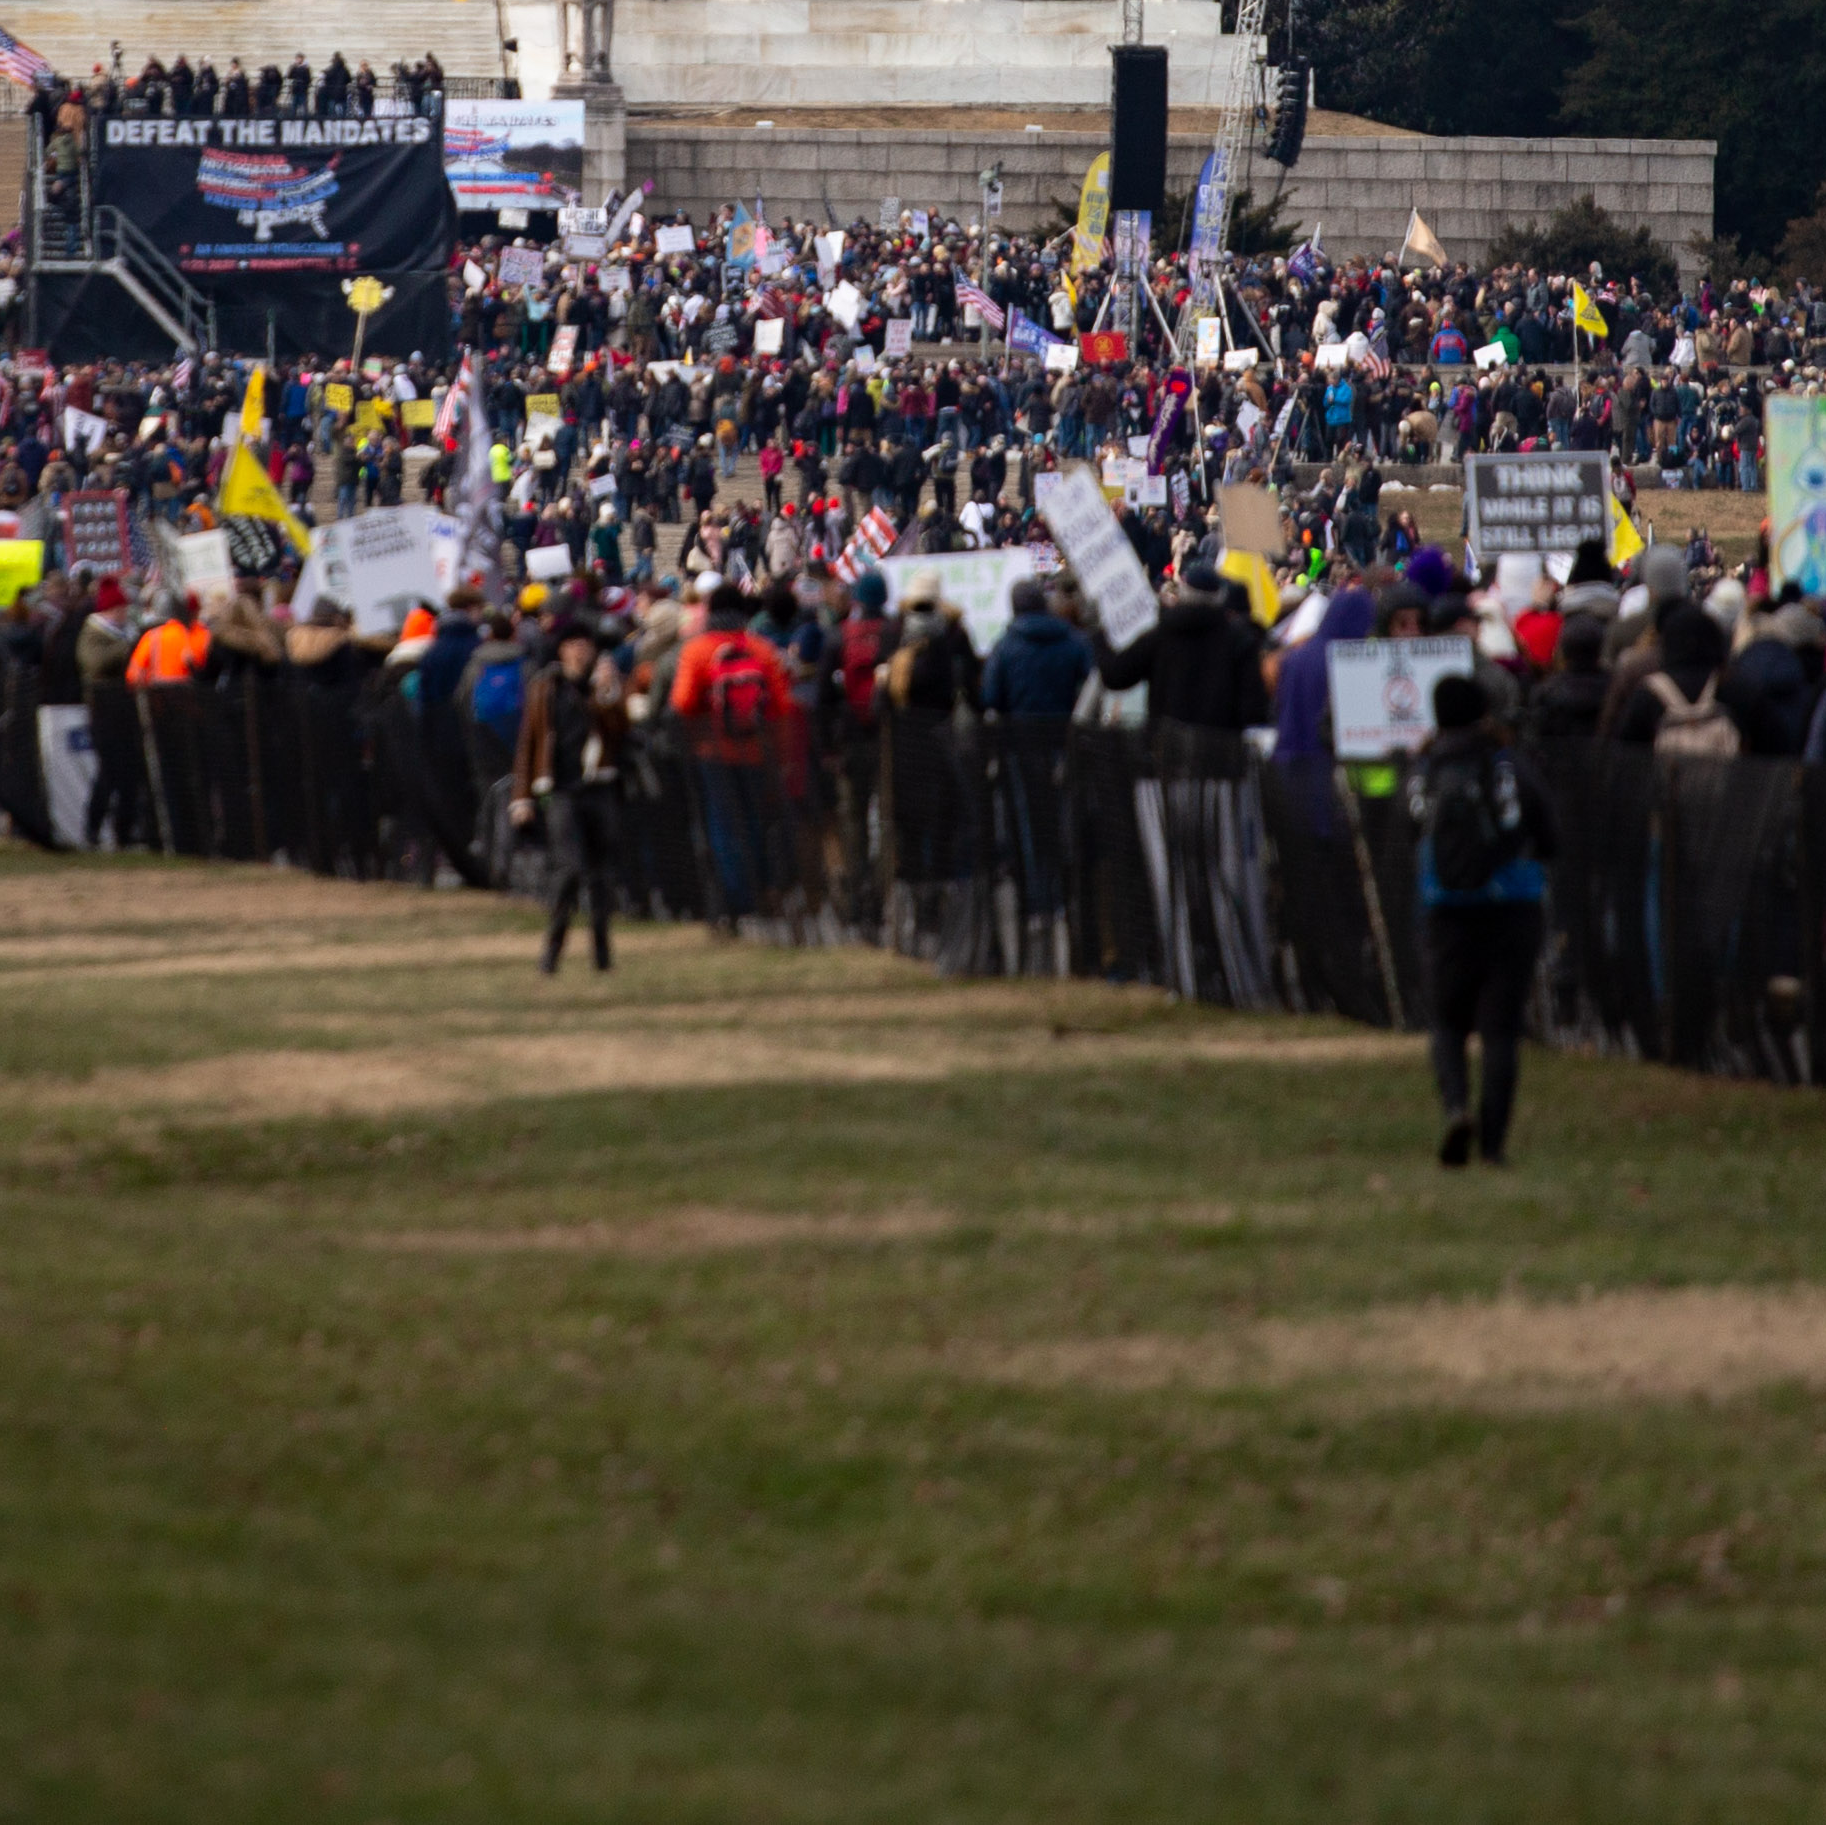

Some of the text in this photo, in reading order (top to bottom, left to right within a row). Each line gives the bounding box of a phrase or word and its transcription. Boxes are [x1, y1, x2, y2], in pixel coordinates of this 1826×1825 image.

[106, 118, 431, 147] DEFEAT THE MANDATES
[1495, 462, 1583, 492] THINK
[1480, 495, 1549, 522] WHILE
[1480, 525, 1535, 550] STILL
